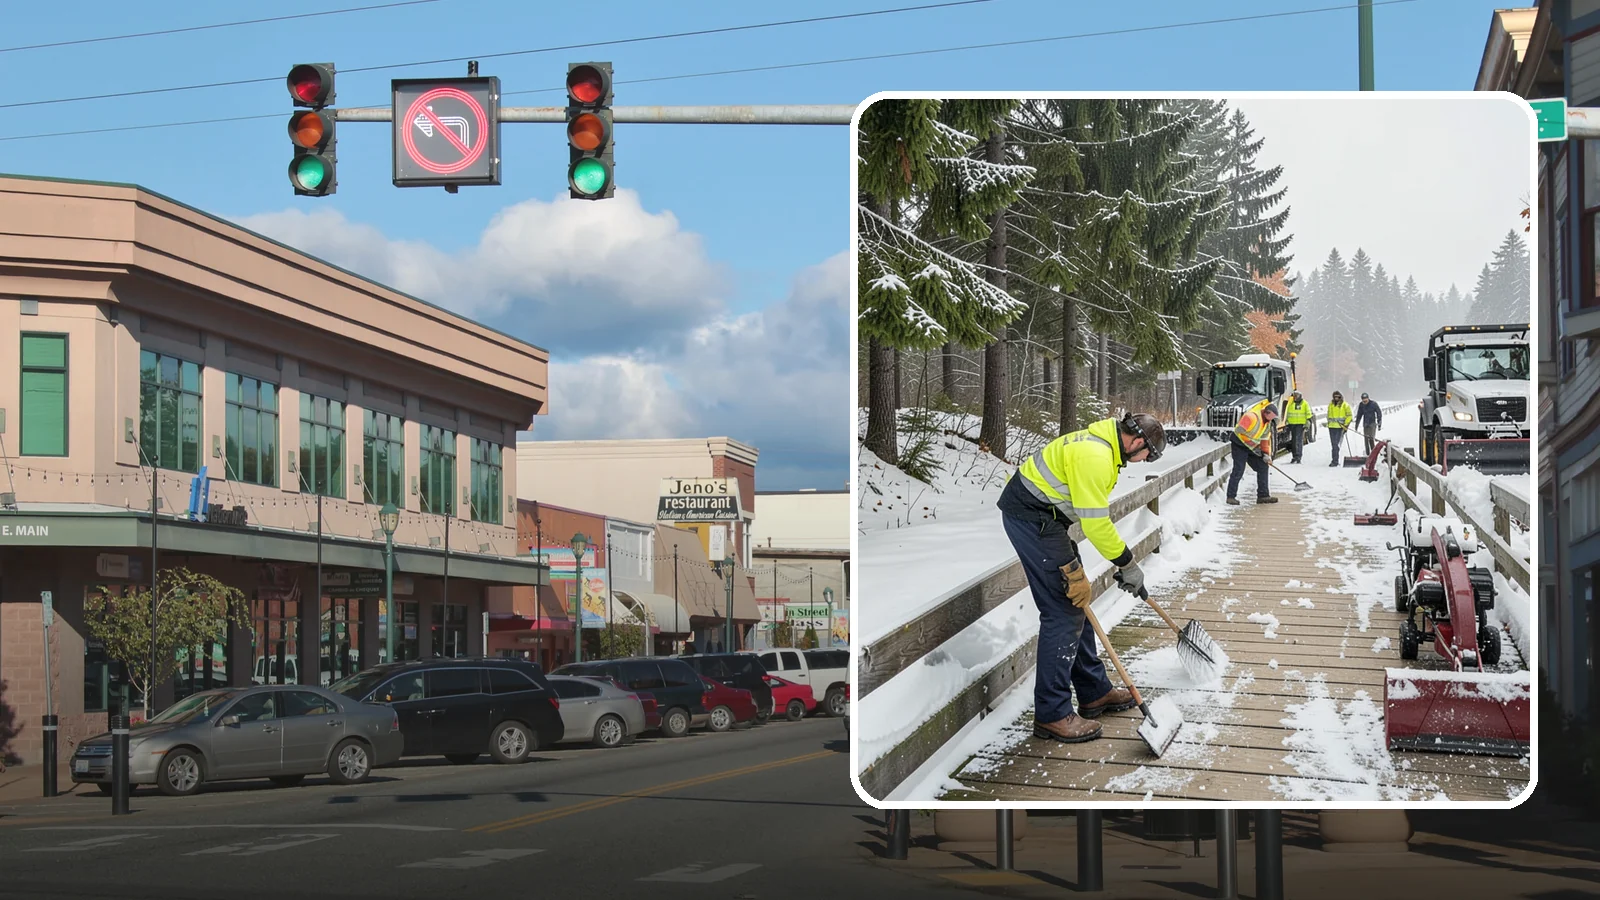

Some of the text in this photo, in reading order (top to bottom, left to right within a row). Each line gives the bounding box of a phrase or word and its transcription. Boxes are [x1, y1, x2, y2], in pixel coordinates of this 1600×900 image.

[670, 480, 728, 494] Jeno's
[665, 497, 730, 508] restaurant
[658, 510, 680, 519] Italian
[686, 510, 714, 518] American
[715, 510, 737, 518] Cuisine
[2, 525, 49, 536] E. MAIN
[797, 607, 828, 617] Street
